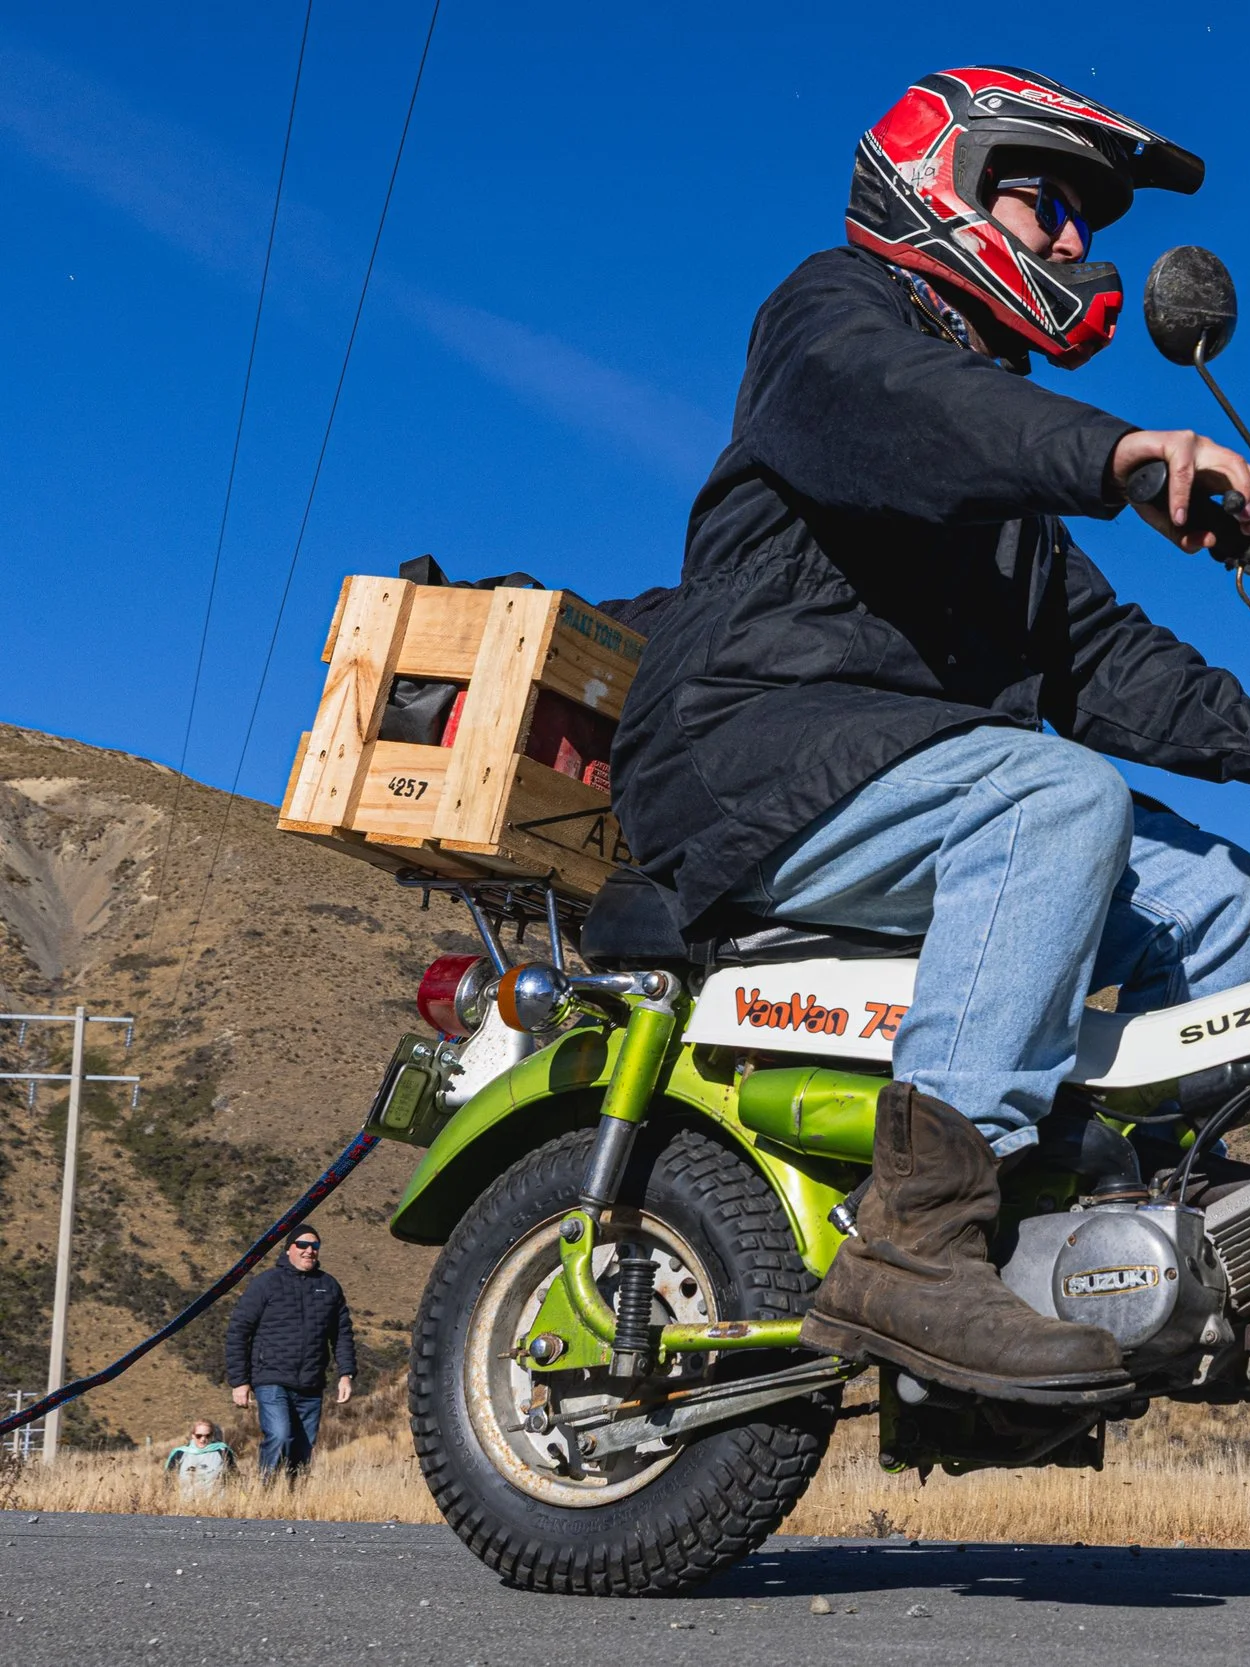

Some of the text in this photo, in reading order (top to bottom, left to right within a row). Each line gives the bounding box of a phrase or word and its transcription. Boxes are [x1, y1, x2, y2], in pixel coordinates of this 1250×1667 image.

[388, 776, 429, 801] 4257
[735, 986, 849, 1037] VanVan
[1067, 1269, 1153, 1294] SUZUKI
